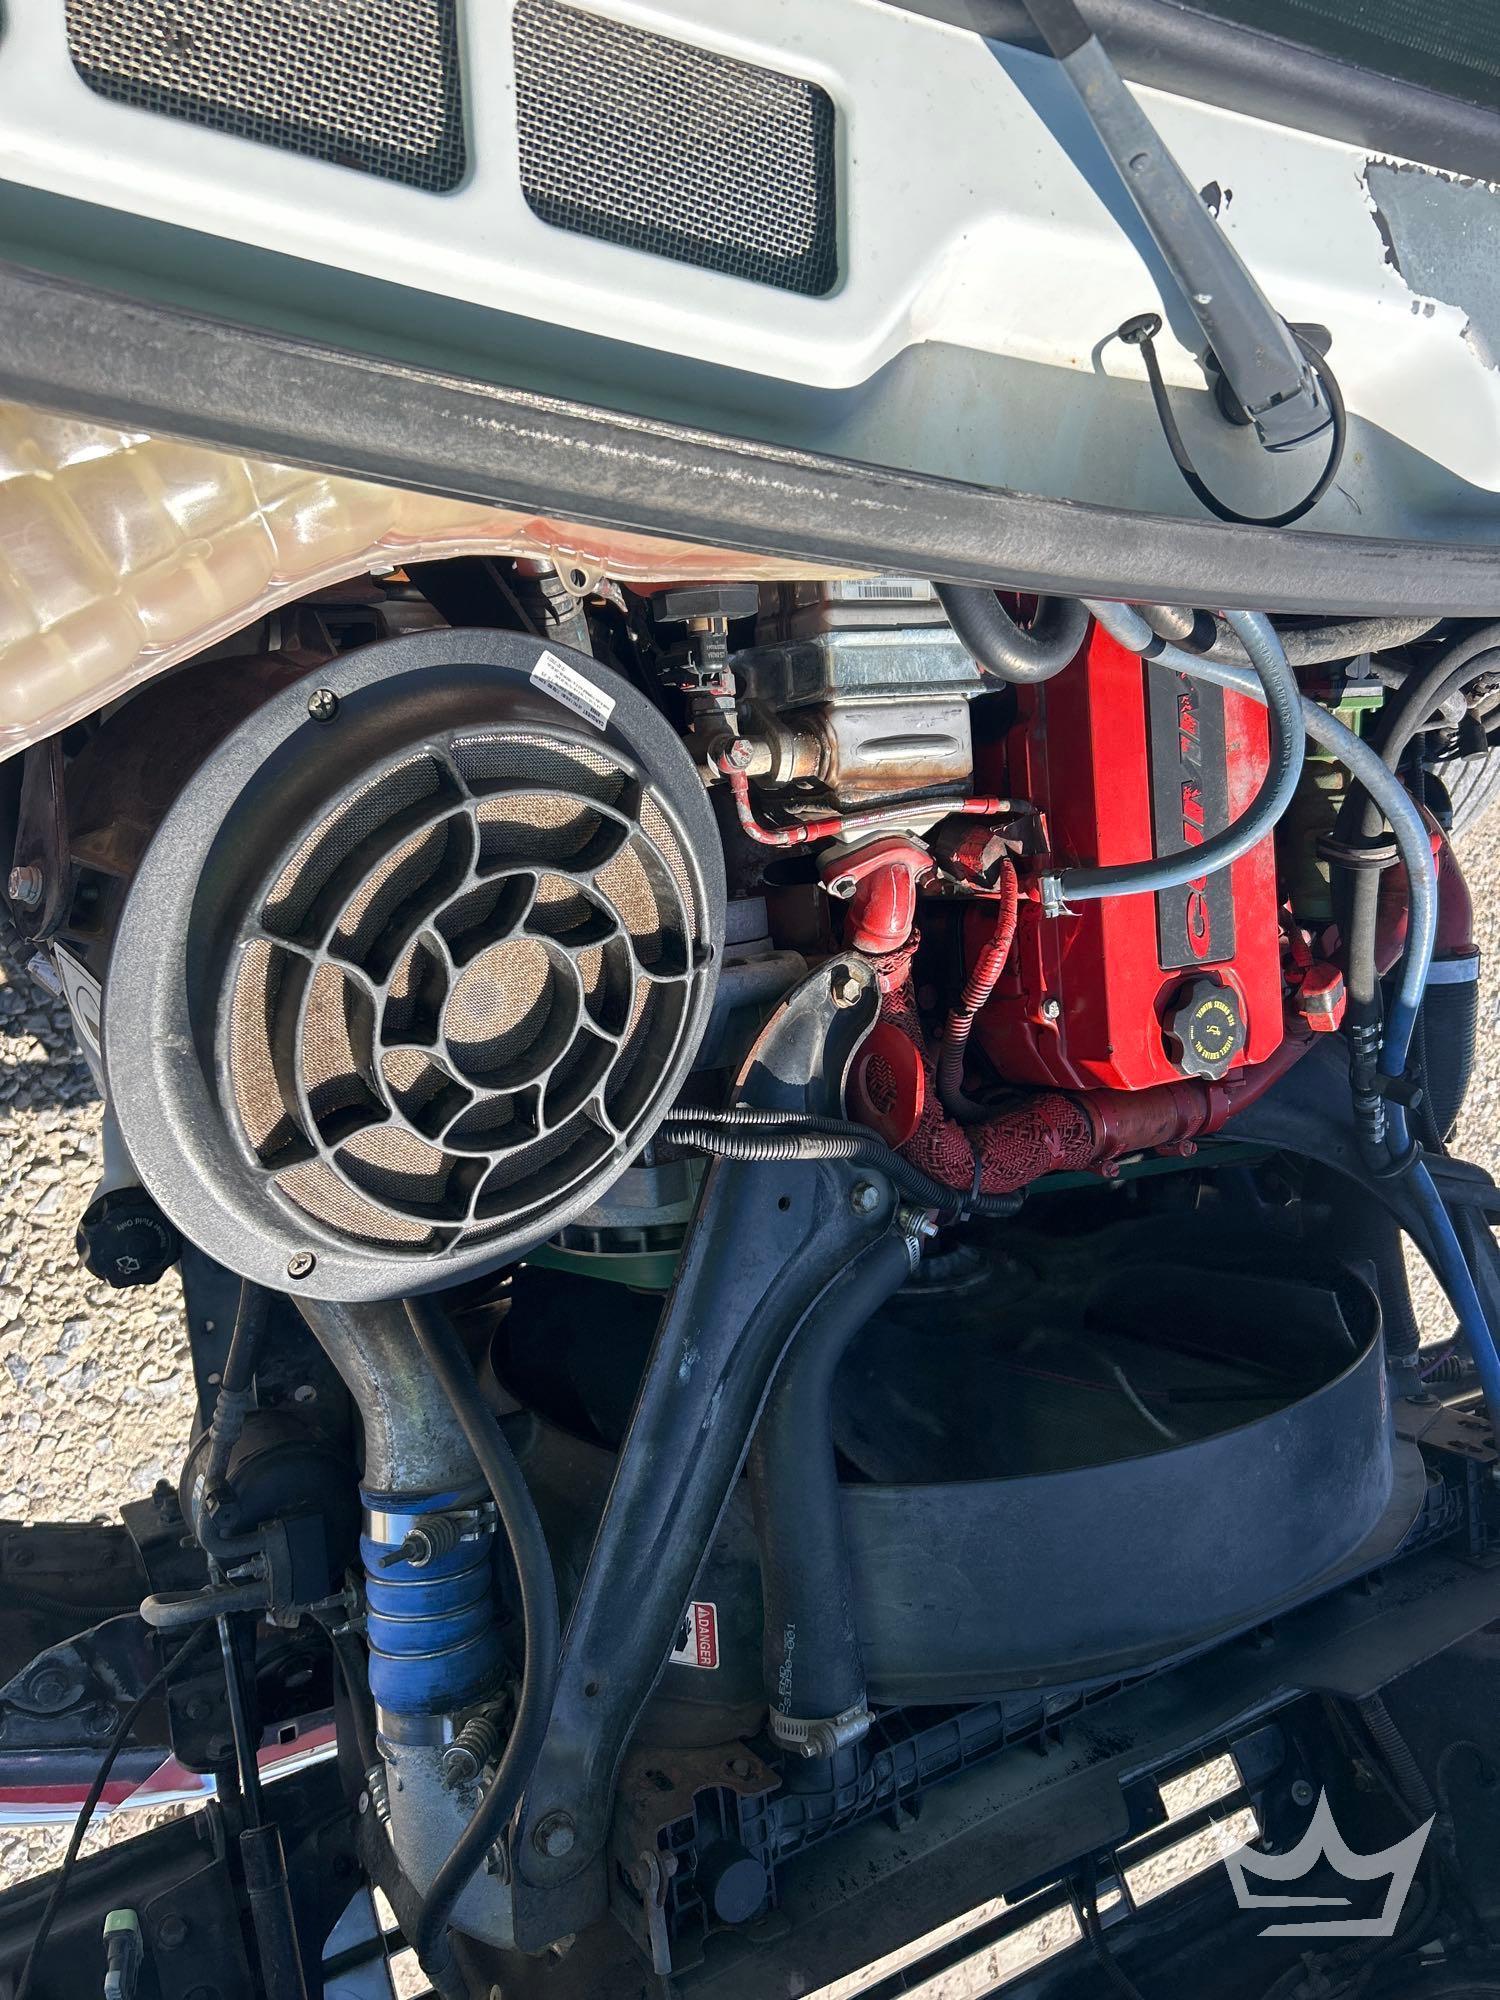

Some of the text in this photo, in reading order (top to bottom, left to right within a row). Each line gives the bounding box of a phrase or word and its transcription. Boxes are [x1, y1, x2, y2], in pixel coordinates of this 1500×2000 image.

[1194, 1035, 1234, 1060] DIESEL ENGINE OIL
[115, 1219, 134, 1232] Only
[699, 1619, 712, 1665] DANGER
[778, 1665, 787, 1696] END
